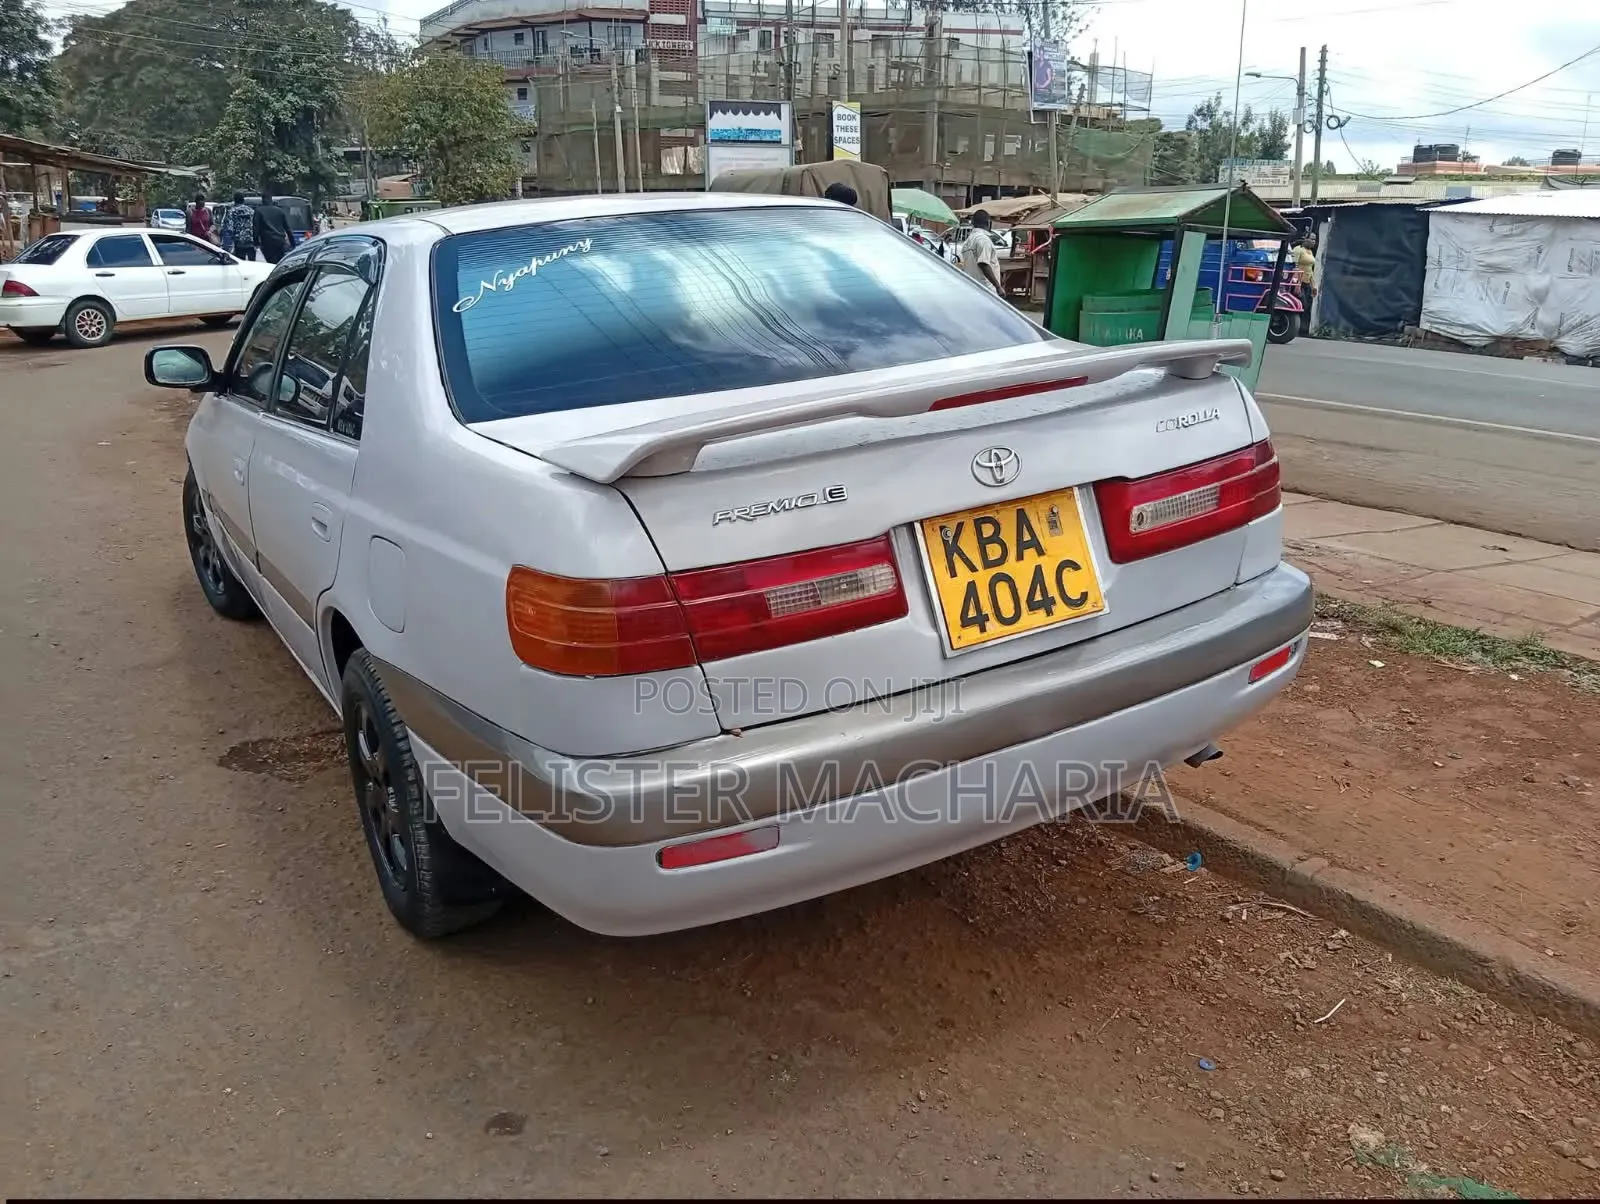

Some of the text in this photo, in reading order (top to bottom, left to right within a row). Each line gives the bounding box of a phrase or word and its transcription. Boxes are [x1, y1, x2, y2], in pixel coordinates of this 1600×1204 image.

[835, 125, 859, 133] THESE
[836, 113, 857, 121] BOOK
[833, 136, 860, 145] SPACES
[1156, 407, 1220, 433] COROLLA
[712, 493, 818, 527] PREMIO
[939, 508, 1046, 579] KBA
[959, 559, 1089, 633] 404C
